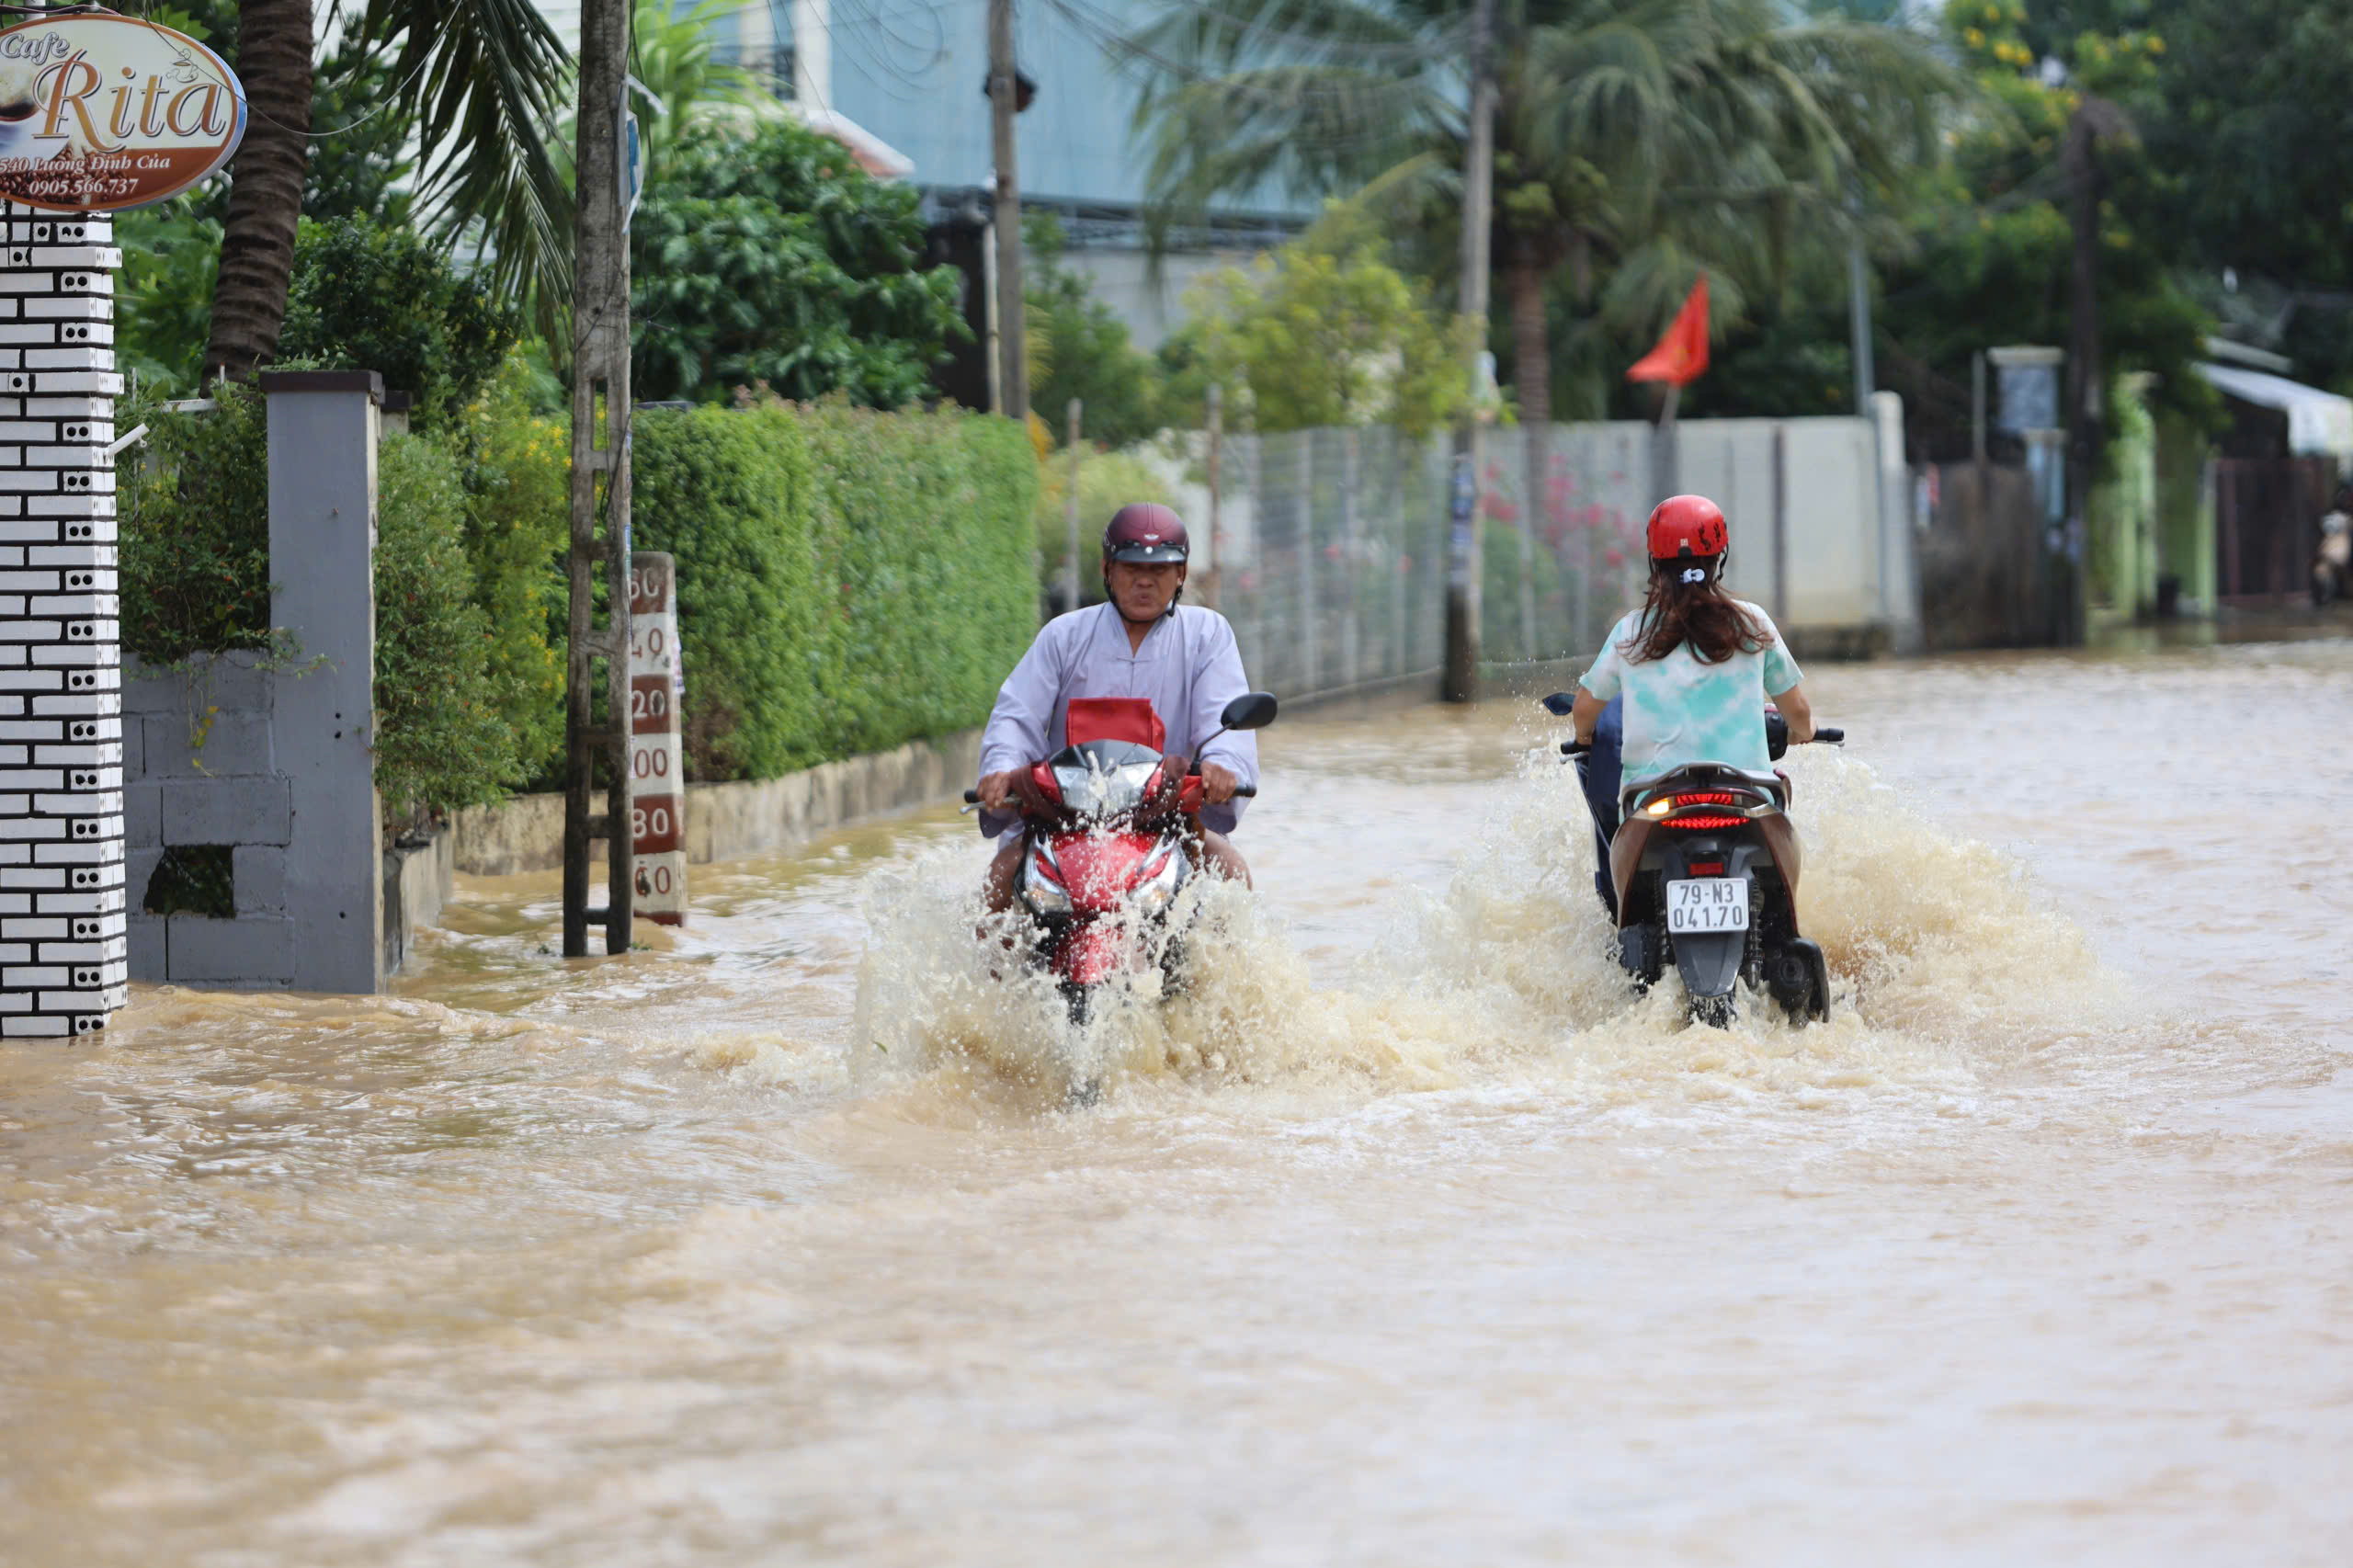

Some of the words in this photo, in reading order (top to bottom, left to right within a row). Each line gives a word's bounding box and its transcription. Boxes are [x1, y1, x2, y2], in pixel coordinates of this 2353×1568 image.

[0, 31, 70, 65] Cafe
[32, 49, 226, 153] Rita
[91, 154, 131, 174] Định
[137, 153, 171, 170] Của
[28, 177, 139, 195] 0905.566.737
[1680, 883, 1733, 904] 79-N3
[1674, 905, 1743, 927] 041.70
